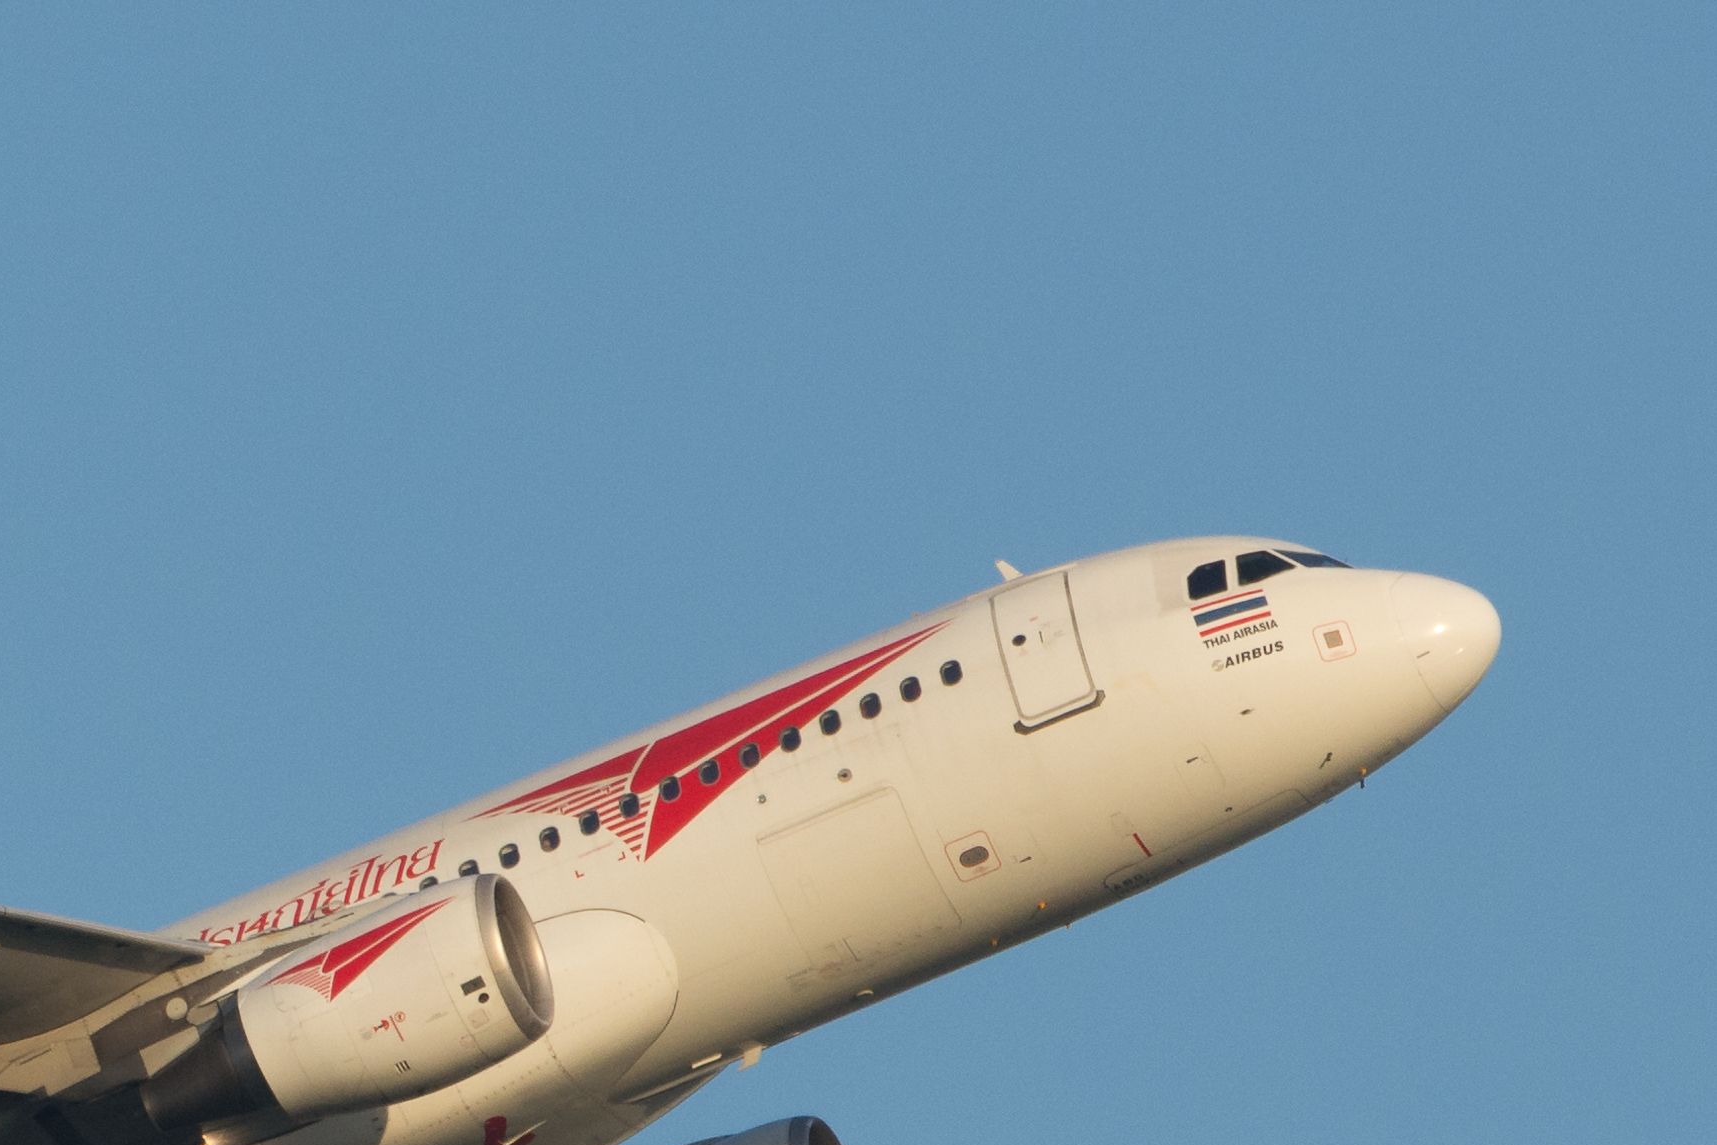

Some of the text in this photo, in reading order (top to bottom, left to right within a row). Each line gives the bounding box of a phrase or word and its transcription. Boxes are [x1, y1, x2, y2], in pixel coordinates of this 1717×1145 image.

[1203, 619, 1279, 649] THAI AIRASIA
[1225, 640, 1285, 669] AIRBUS
